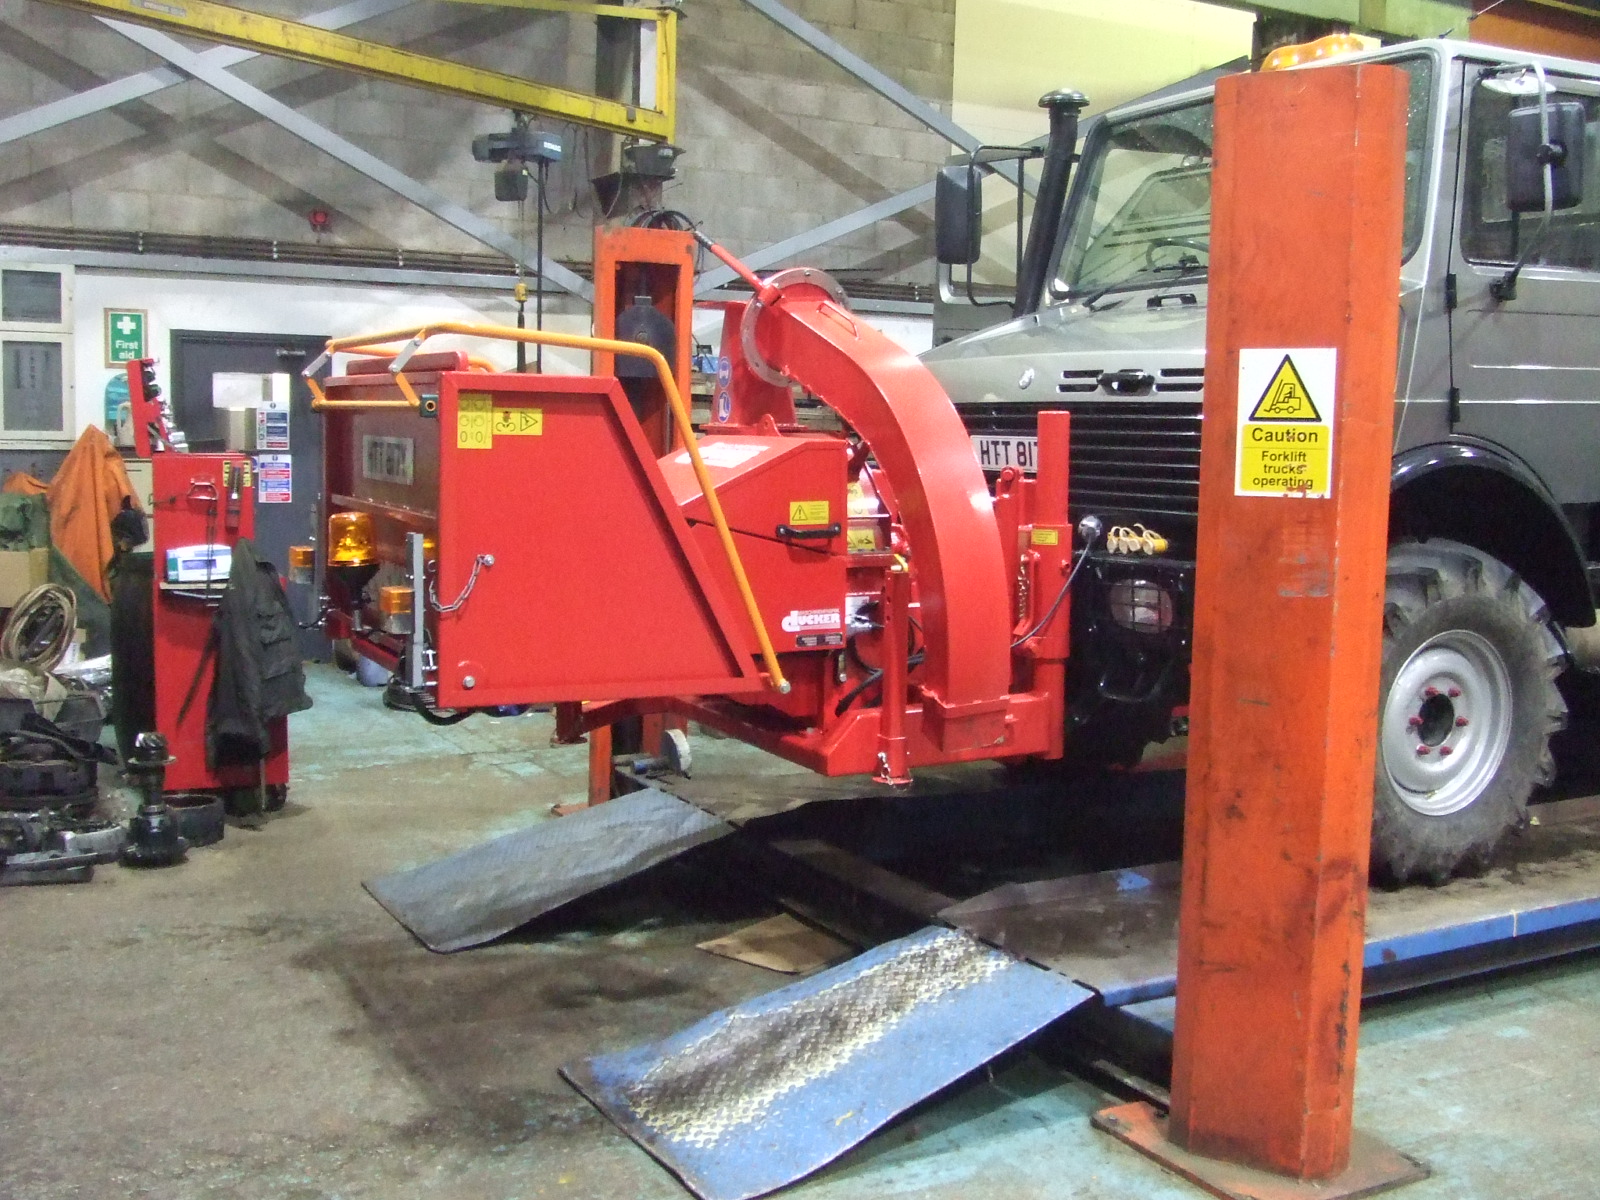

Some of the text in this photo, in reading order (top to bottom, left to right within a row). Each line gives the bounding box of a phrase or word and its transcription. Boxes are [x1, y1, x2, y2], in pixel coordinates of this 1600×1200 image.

[115, 340, 139, 350] First
[118, 350, 135, 360] aid
[1252, 427, 1318, 443] Caution
[1261, 450, 1307, 462] Forklift
[1263, 463, 1304, 475] trucks
[1252, 476, 1314, 490] operating
